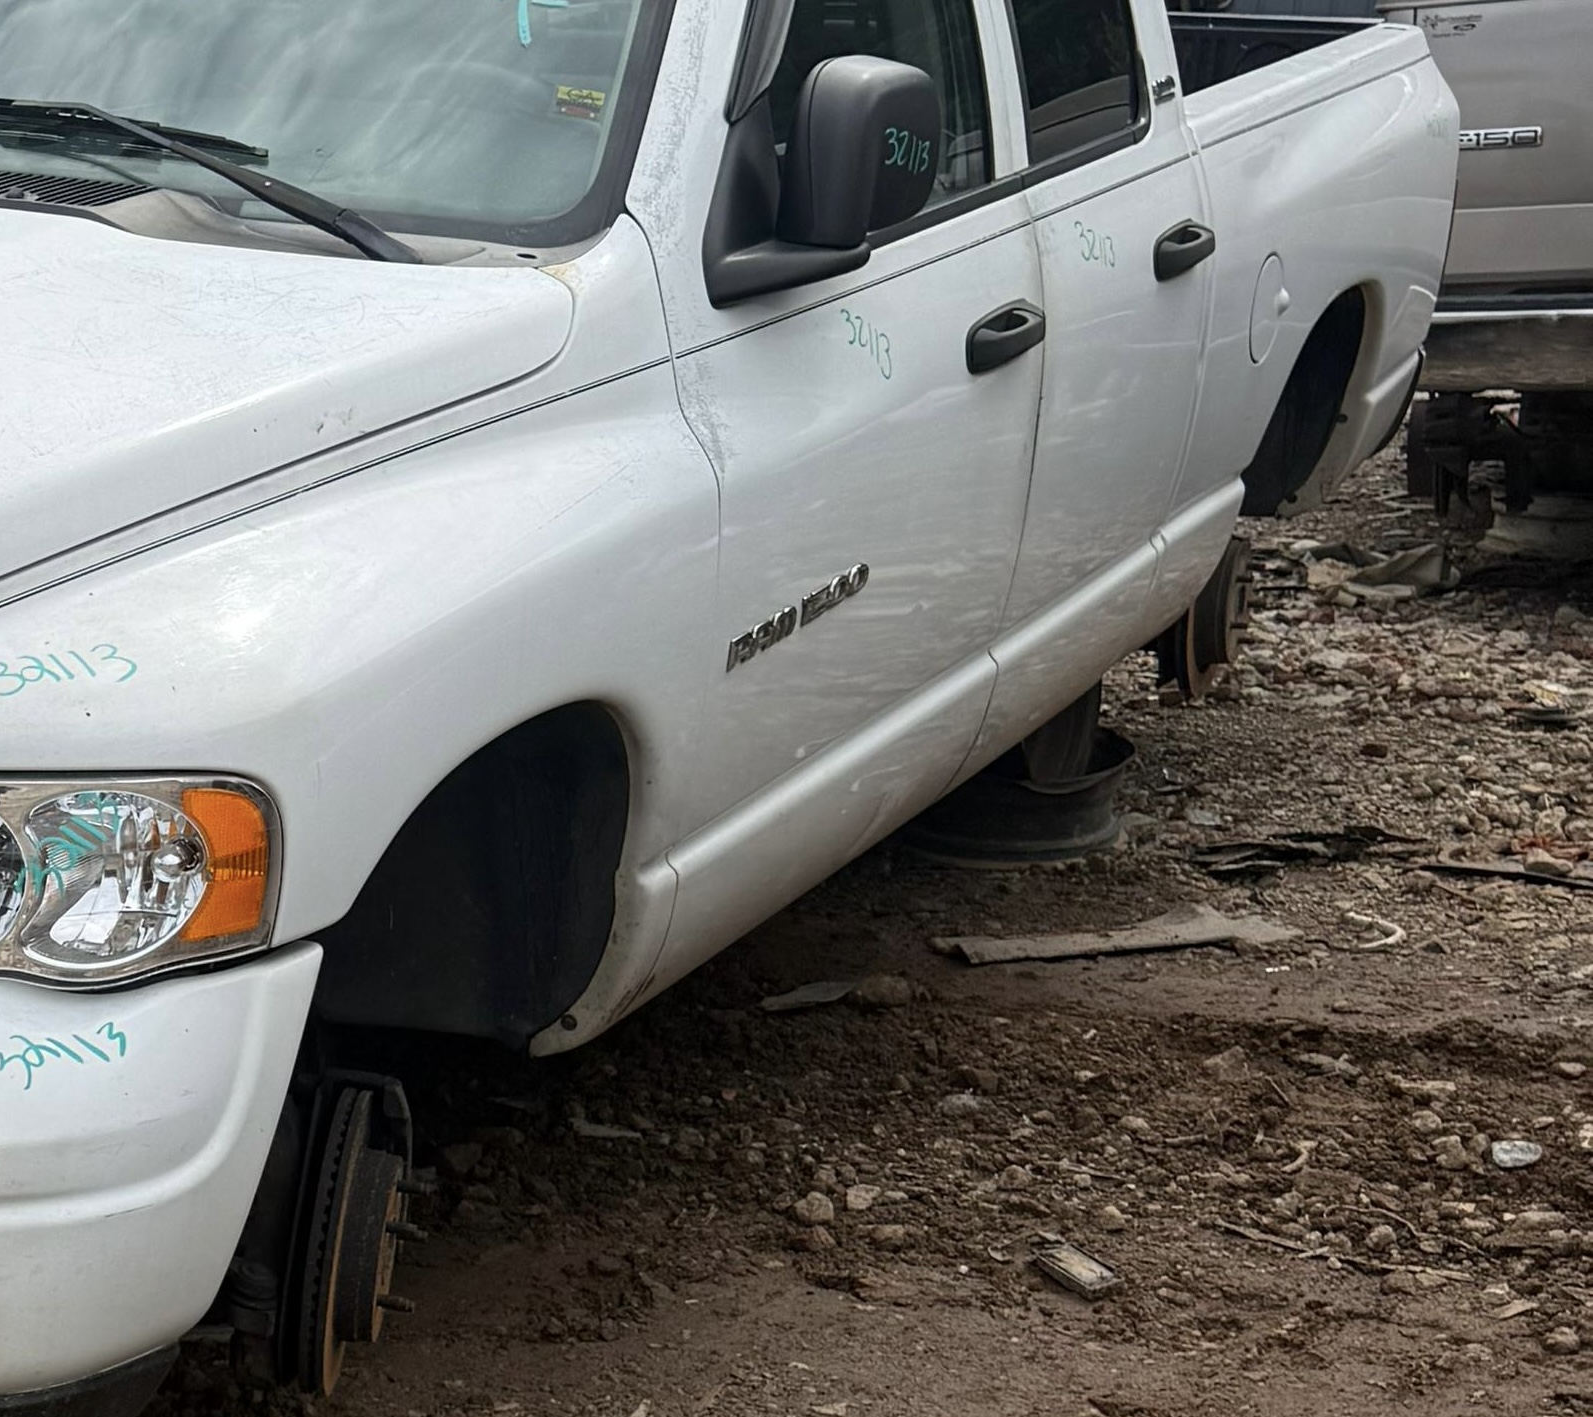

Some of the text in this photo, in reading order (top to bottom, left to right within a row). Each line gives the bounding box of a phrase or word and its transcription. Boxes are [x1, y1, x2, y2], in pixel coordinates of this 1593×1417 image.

[884, 127, 931, 174] 32113
[1073, 221, 1117, 268] 32113
[840, 309, 892, 380] 32113
